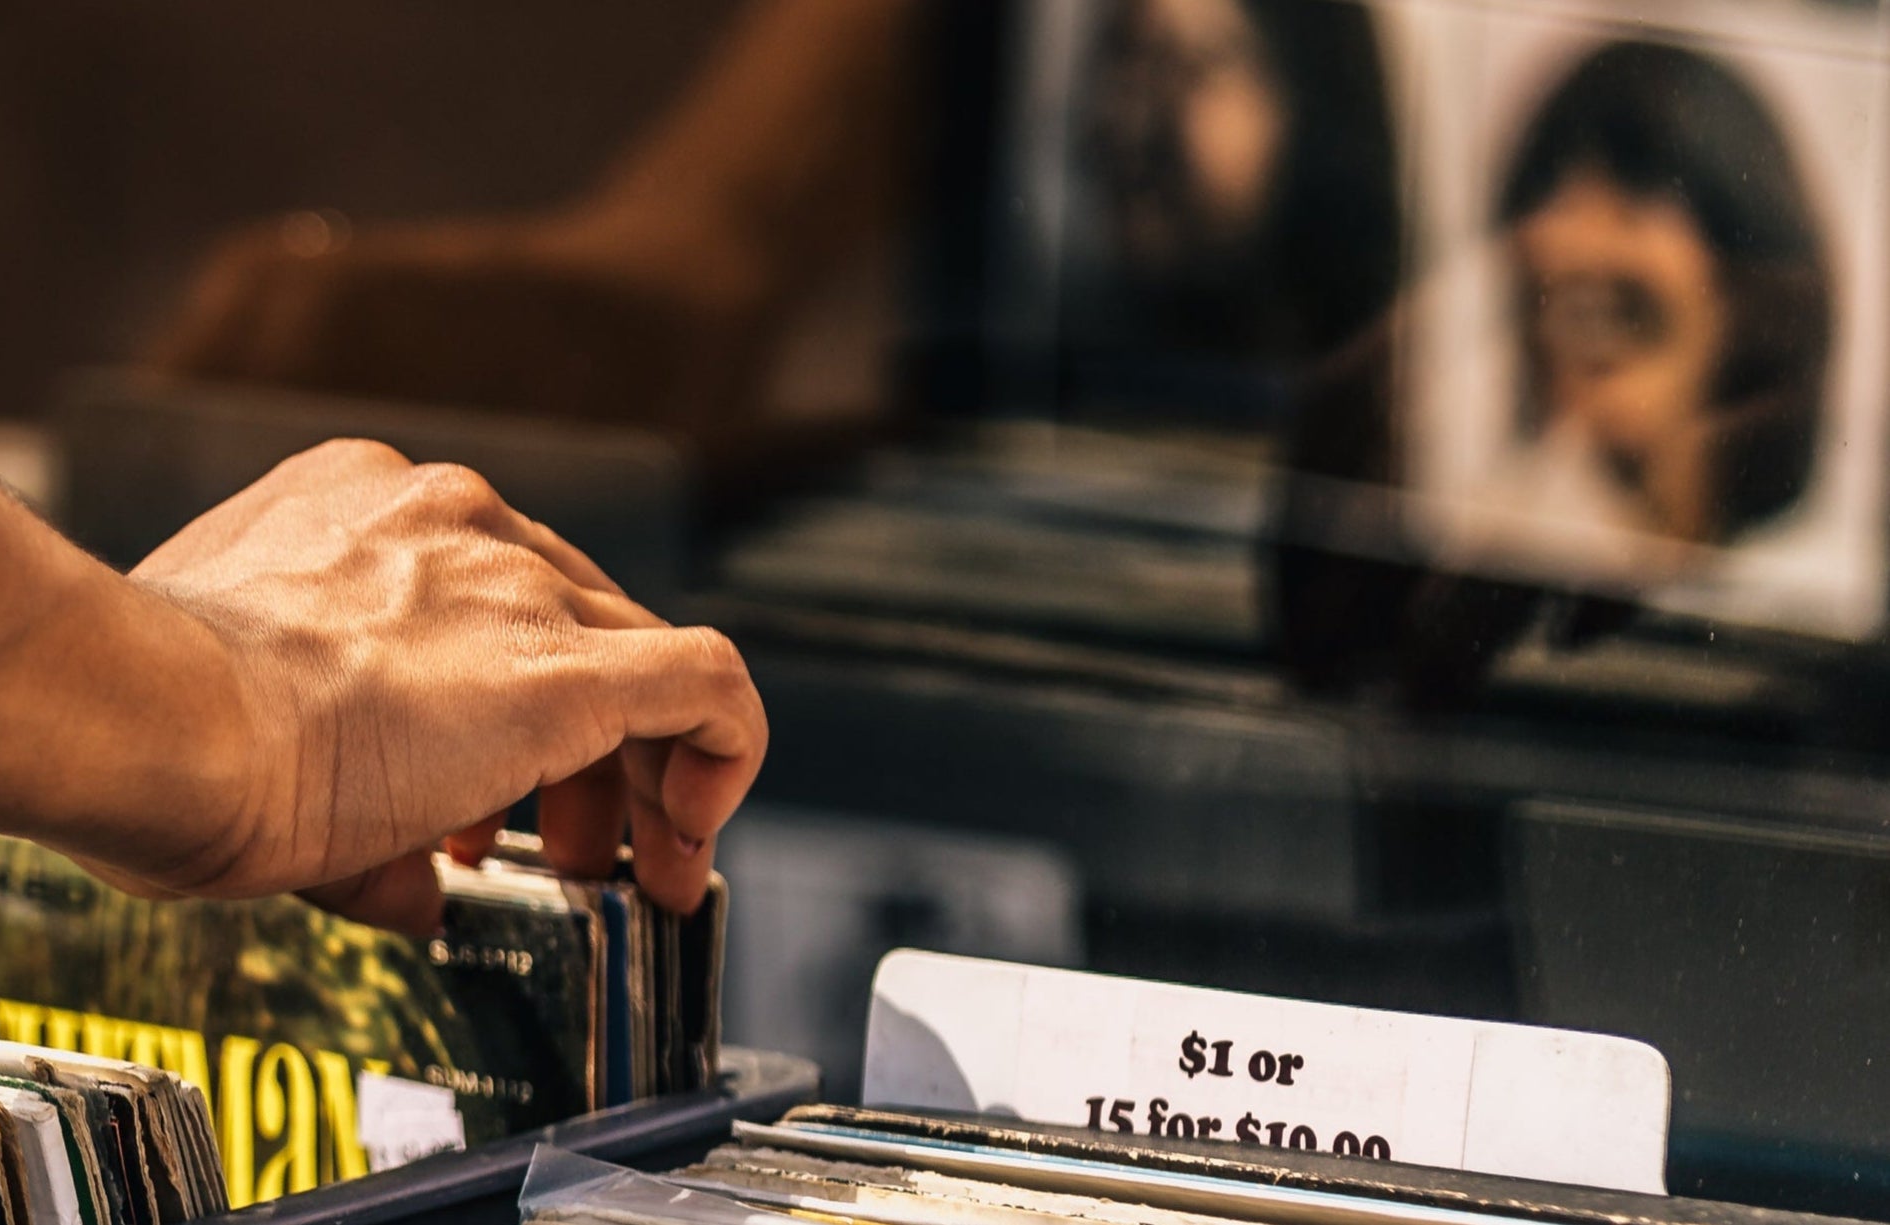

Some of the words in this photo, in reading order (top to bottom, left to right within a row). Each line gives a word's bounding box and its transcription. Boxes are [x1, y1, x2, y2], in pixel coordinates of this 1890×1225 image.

[1179, 1029, 1234, 1079] $1
[1248, 1049, 1304, 1086] or
[1085, 1096, 1136, 1135] 15
[1148, 1097, 1222, 1139] for
[1236, 1111, 1391, 1161] $1000
